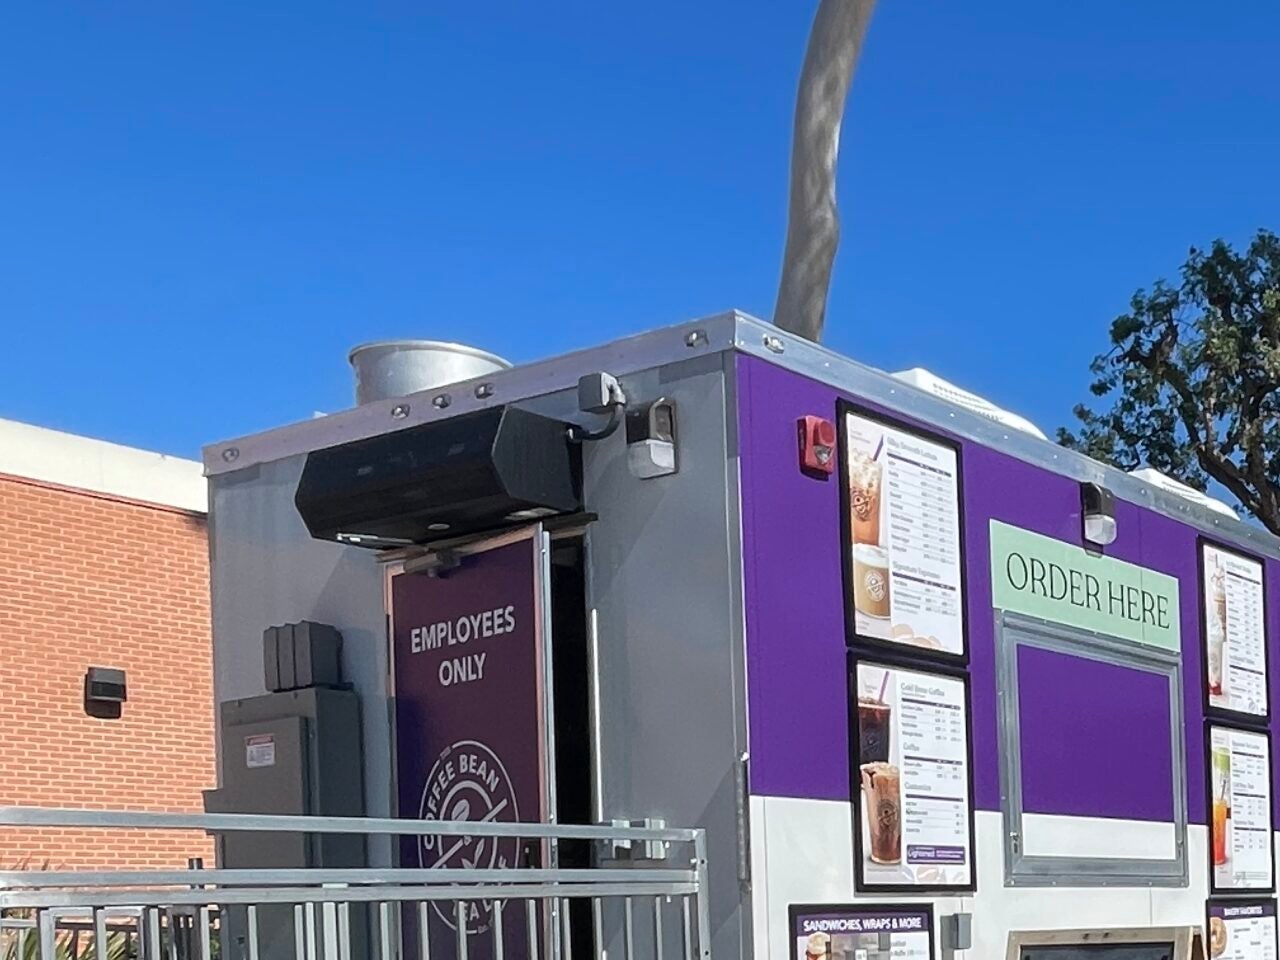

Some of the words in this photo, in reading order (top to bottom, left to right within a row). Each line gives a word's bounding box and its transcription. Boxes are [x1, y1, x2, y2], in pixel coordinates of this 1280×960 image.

[1007, 552, 1101, 612] ORDER
[1107, 580, 1170, 629] HERE
[411, 605, 516, 653] EMPLOYEES
[438, 652, 487, 687] ONLY
[459, 754, 500, 793] BEAN
[803, 919, 862, 932] SANDWICHES,
[862, 918, 891, 930] WRAPS
[899, 917, 922, 928] MORE
